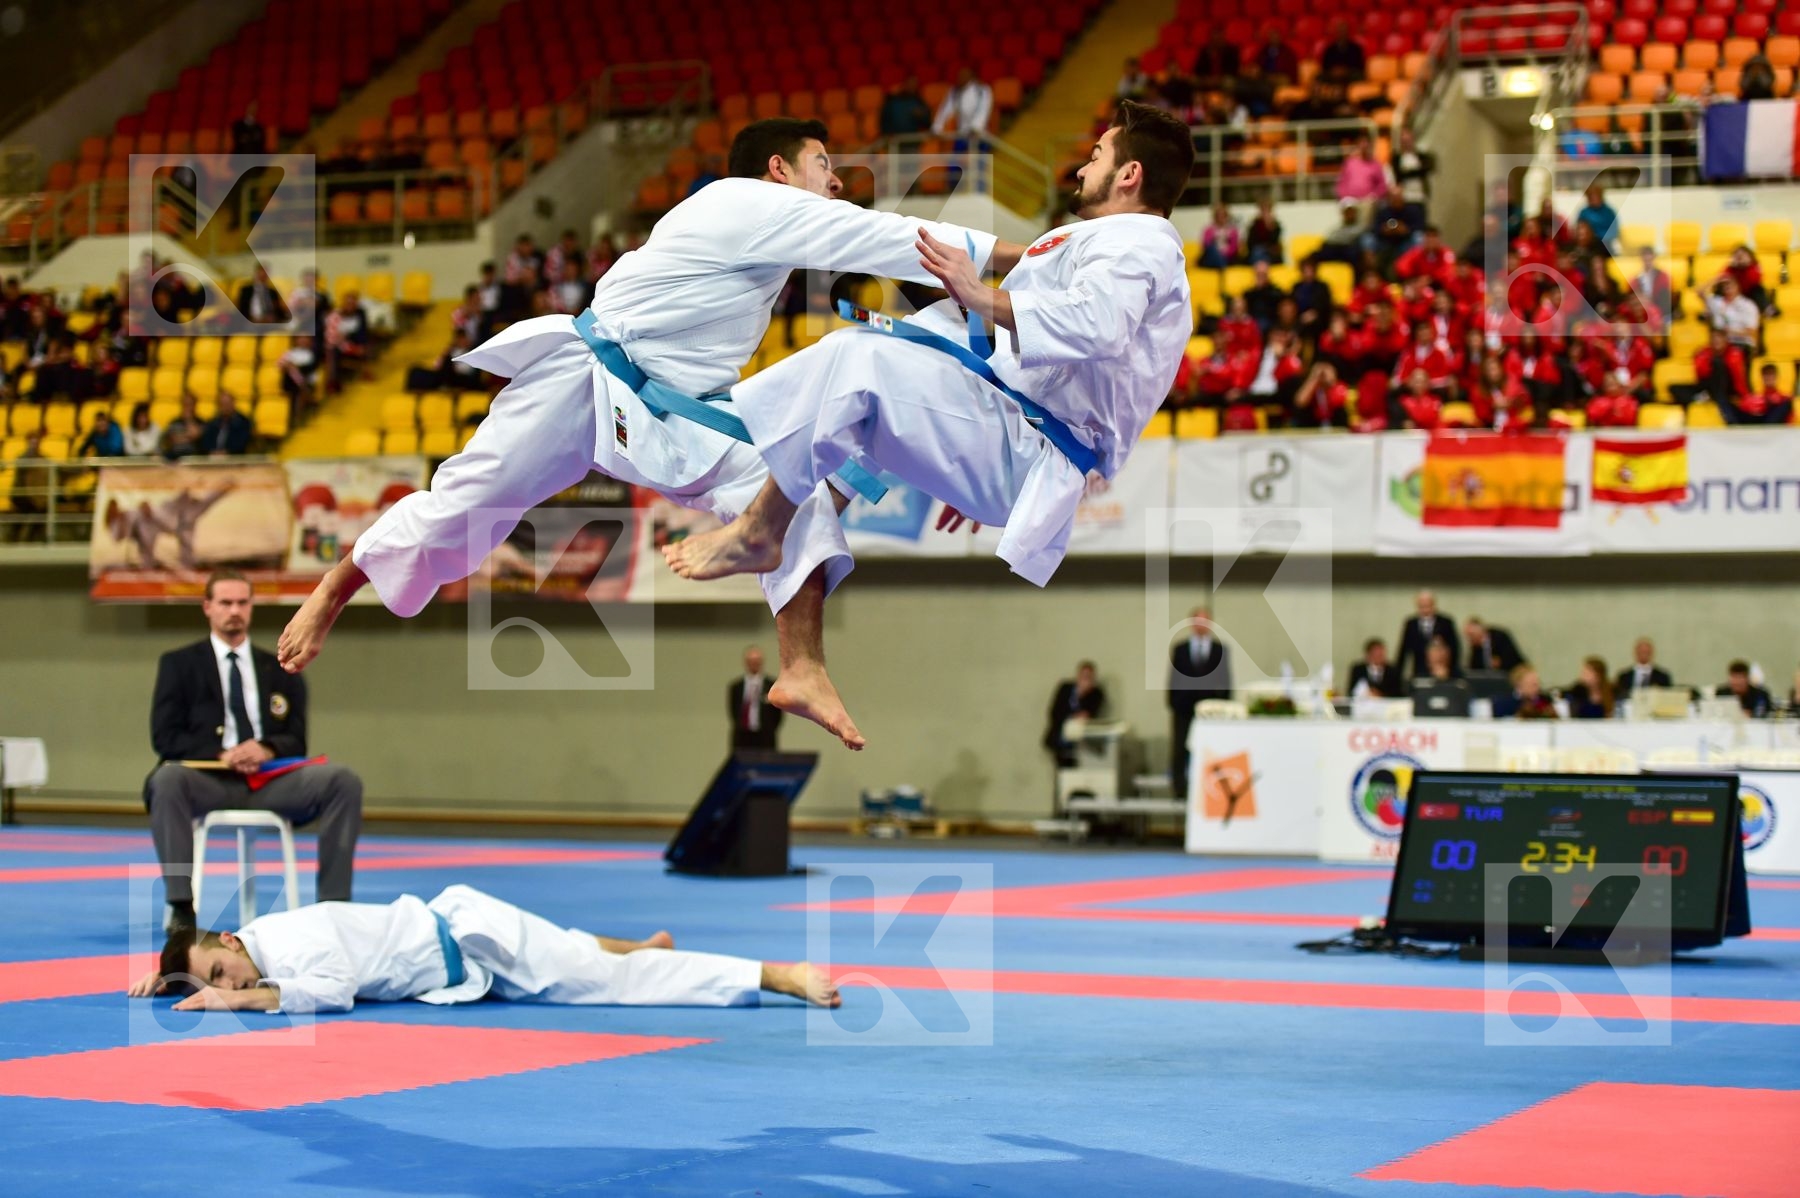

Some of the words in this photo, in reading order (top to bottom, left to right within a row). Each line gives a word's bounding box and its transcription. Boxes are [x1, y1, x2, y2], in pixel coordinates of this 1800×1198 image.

[1347, 729, 1438, 754] COACH
[1464, 806, 1504, 822] TUR
[1627, 810, 1667, 825] ESP
[1431, 839, 1477, 871] 00
[1520, 841, 1598, 874] 2:34
[1642, 845, 1689, 876] 00
